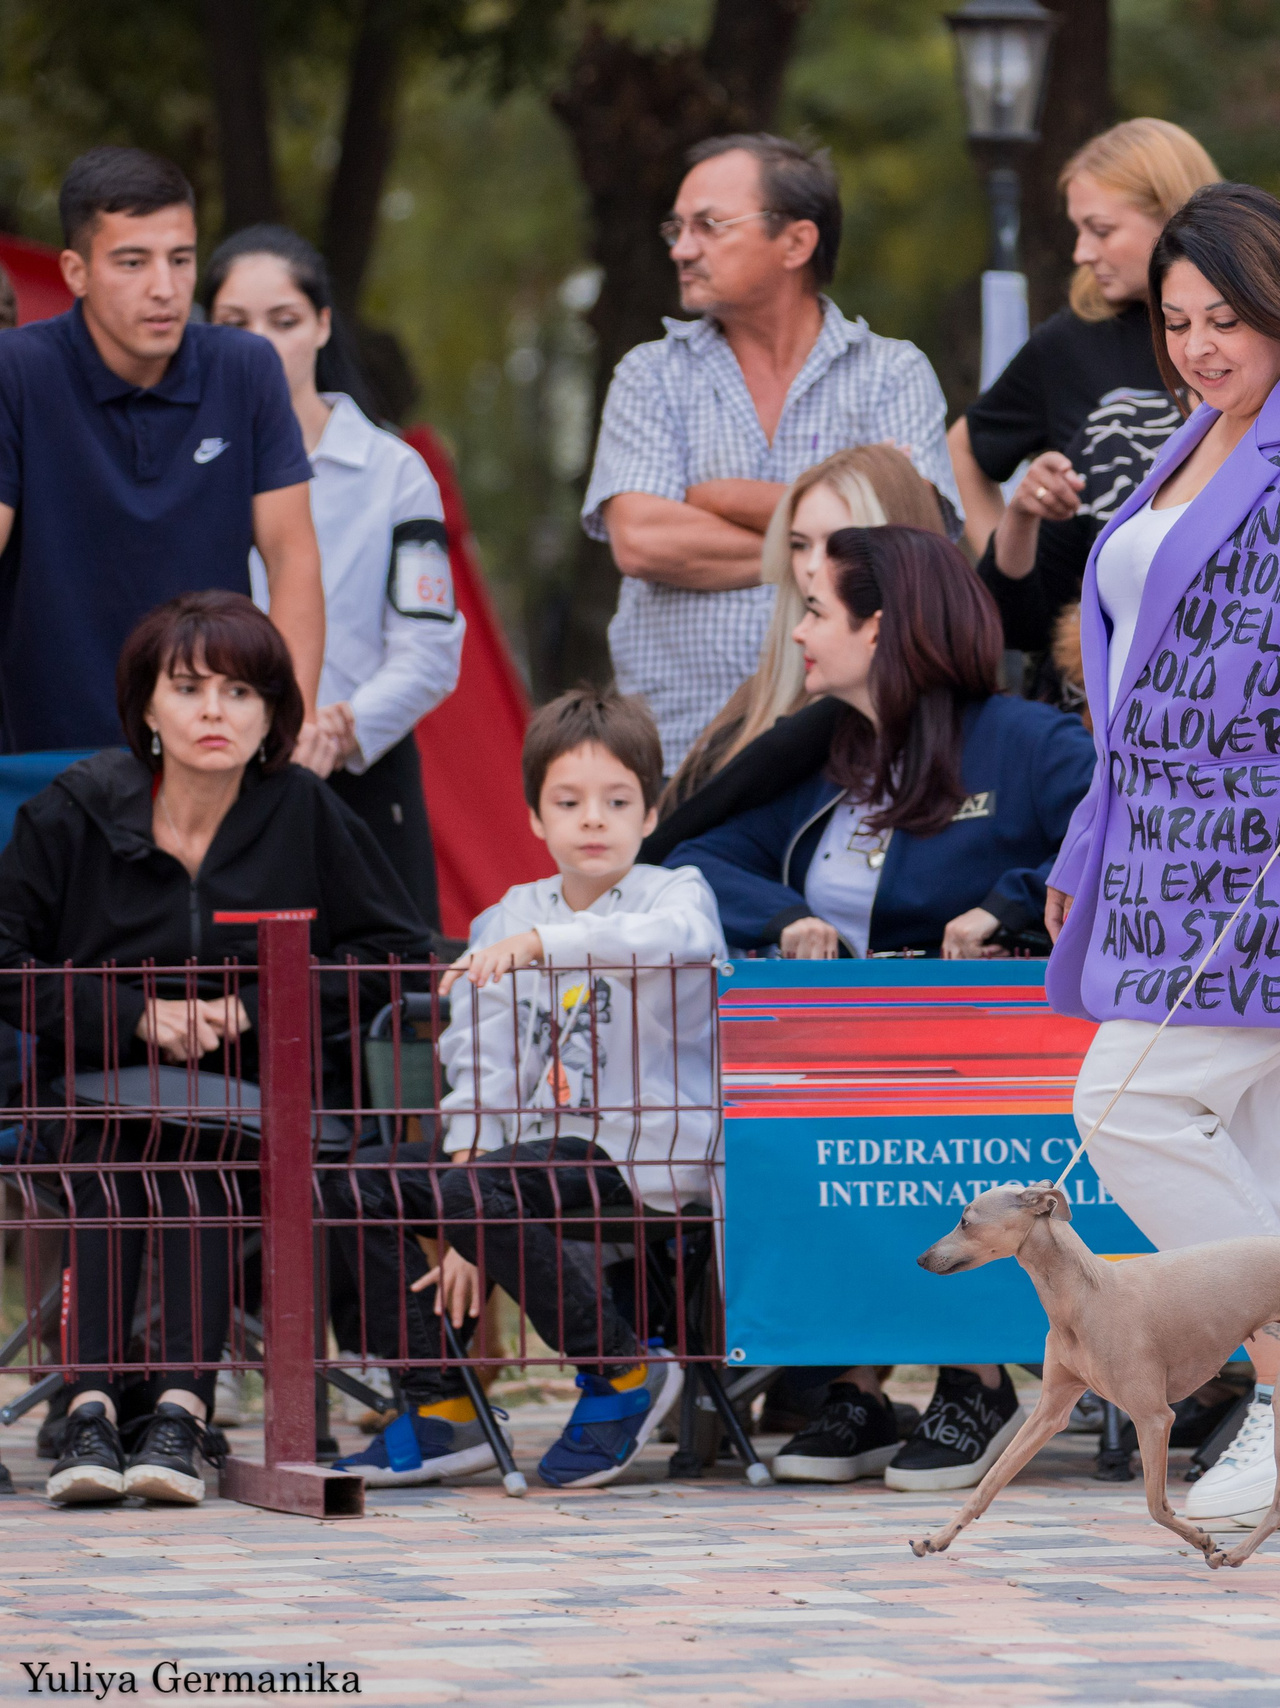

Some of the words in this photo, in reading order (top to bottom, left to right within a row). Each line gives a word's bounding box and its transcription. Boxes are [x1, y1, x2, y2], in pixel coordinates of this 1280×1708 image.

[416, 573, 448, 606] 62
[1103, 861, 1149, 908] ELL
[1101, 908, 1166, 961] AND
[816, 1138, 1031, 1165] FEDERATION
[913, 1411, 981, 1460] Klein
